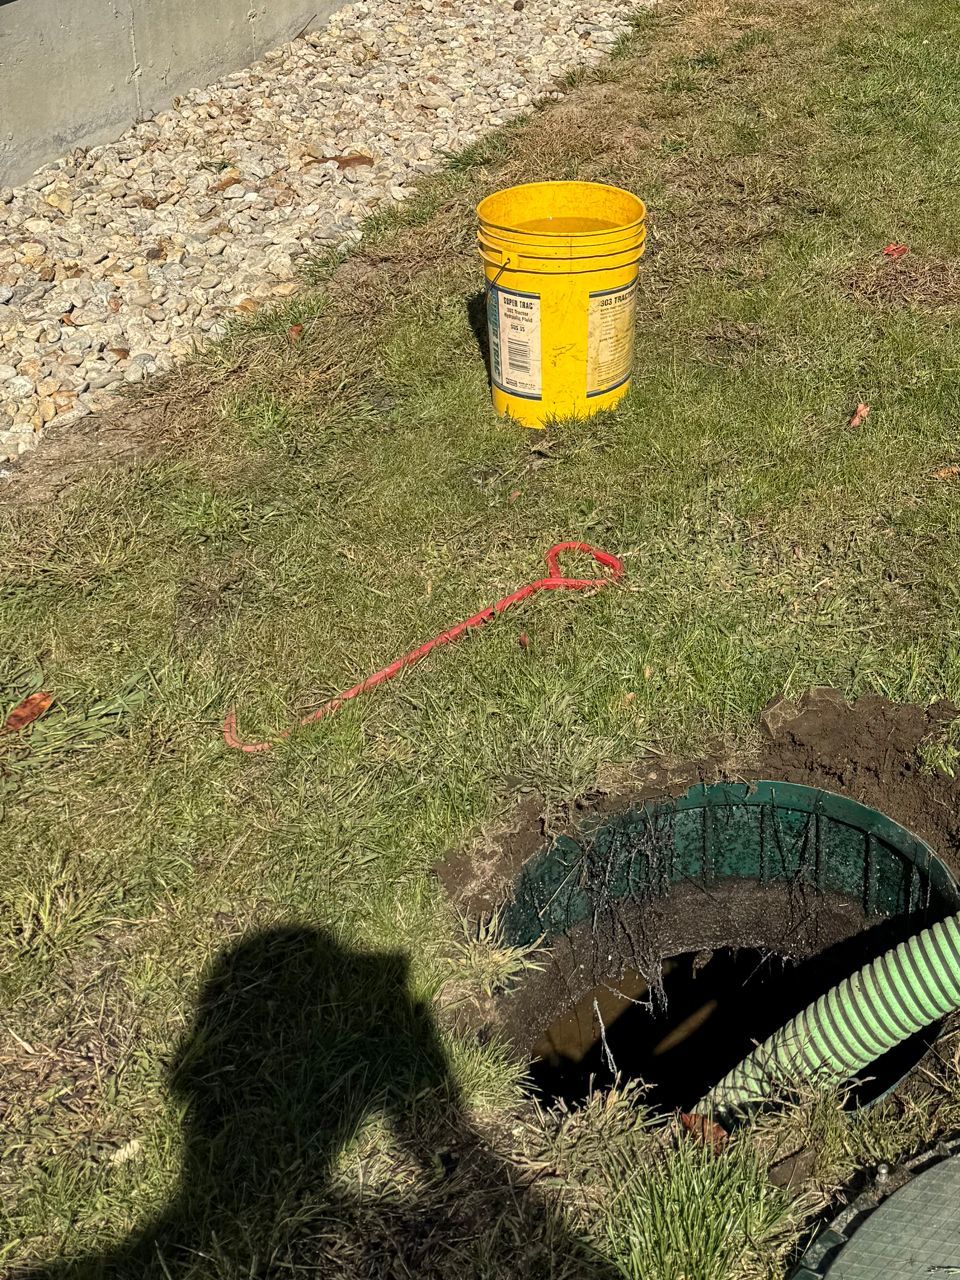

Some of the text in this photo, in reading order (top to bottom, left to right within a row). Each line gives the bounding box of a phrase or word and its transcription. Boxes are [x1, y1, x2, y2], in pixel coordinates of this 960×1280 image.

[503, 296, 532, 309] SUPER TRAC
[600, 298, 612, 307] 303
